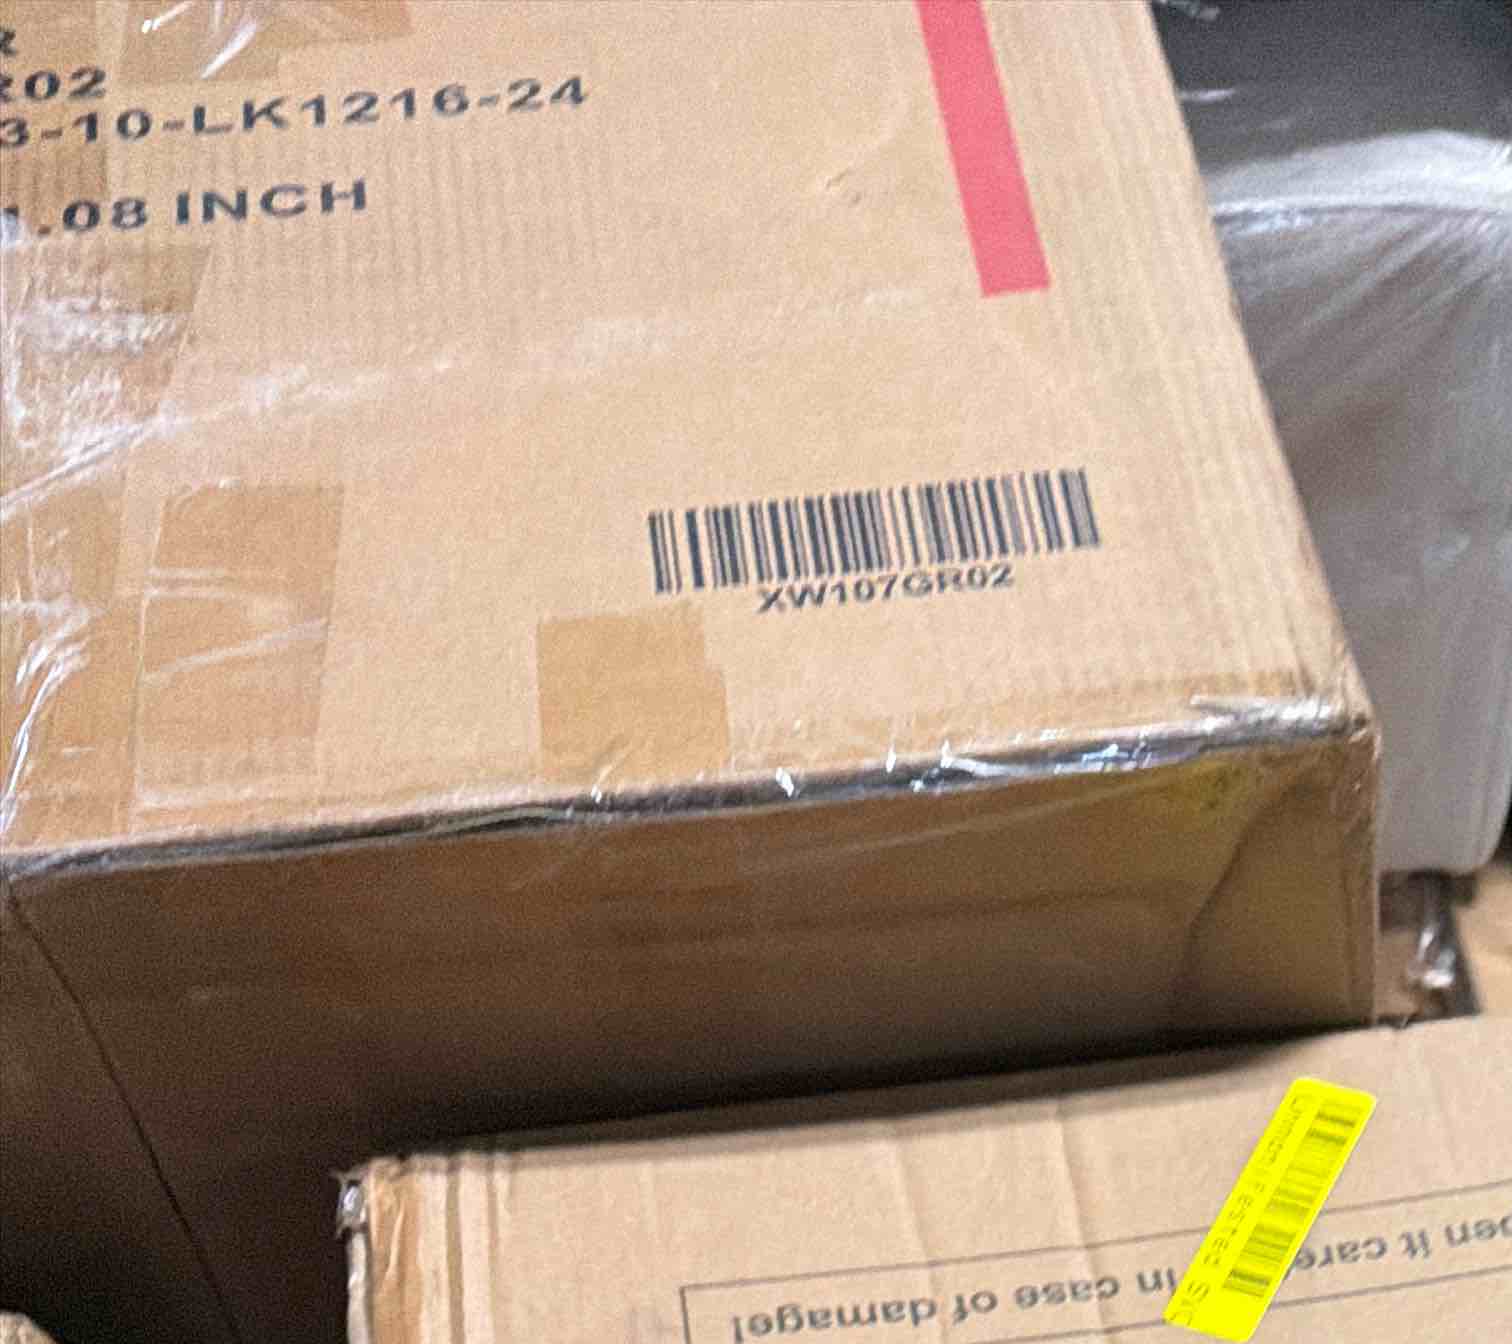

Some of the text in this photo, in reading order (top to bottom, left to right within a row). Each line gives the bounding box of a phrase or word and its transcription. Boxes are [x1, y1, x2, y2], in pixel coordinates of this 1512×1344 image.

[175, 178, 366, 225] INCH
[757, 563, 1015, 614] XW107GR02
[1400, 1231, 1431, 1258] it
[952, 1290, 998, 1325] of
[1015, 1276, 1119, 1310] case
[733, 1297, 936, 1344] damage!
